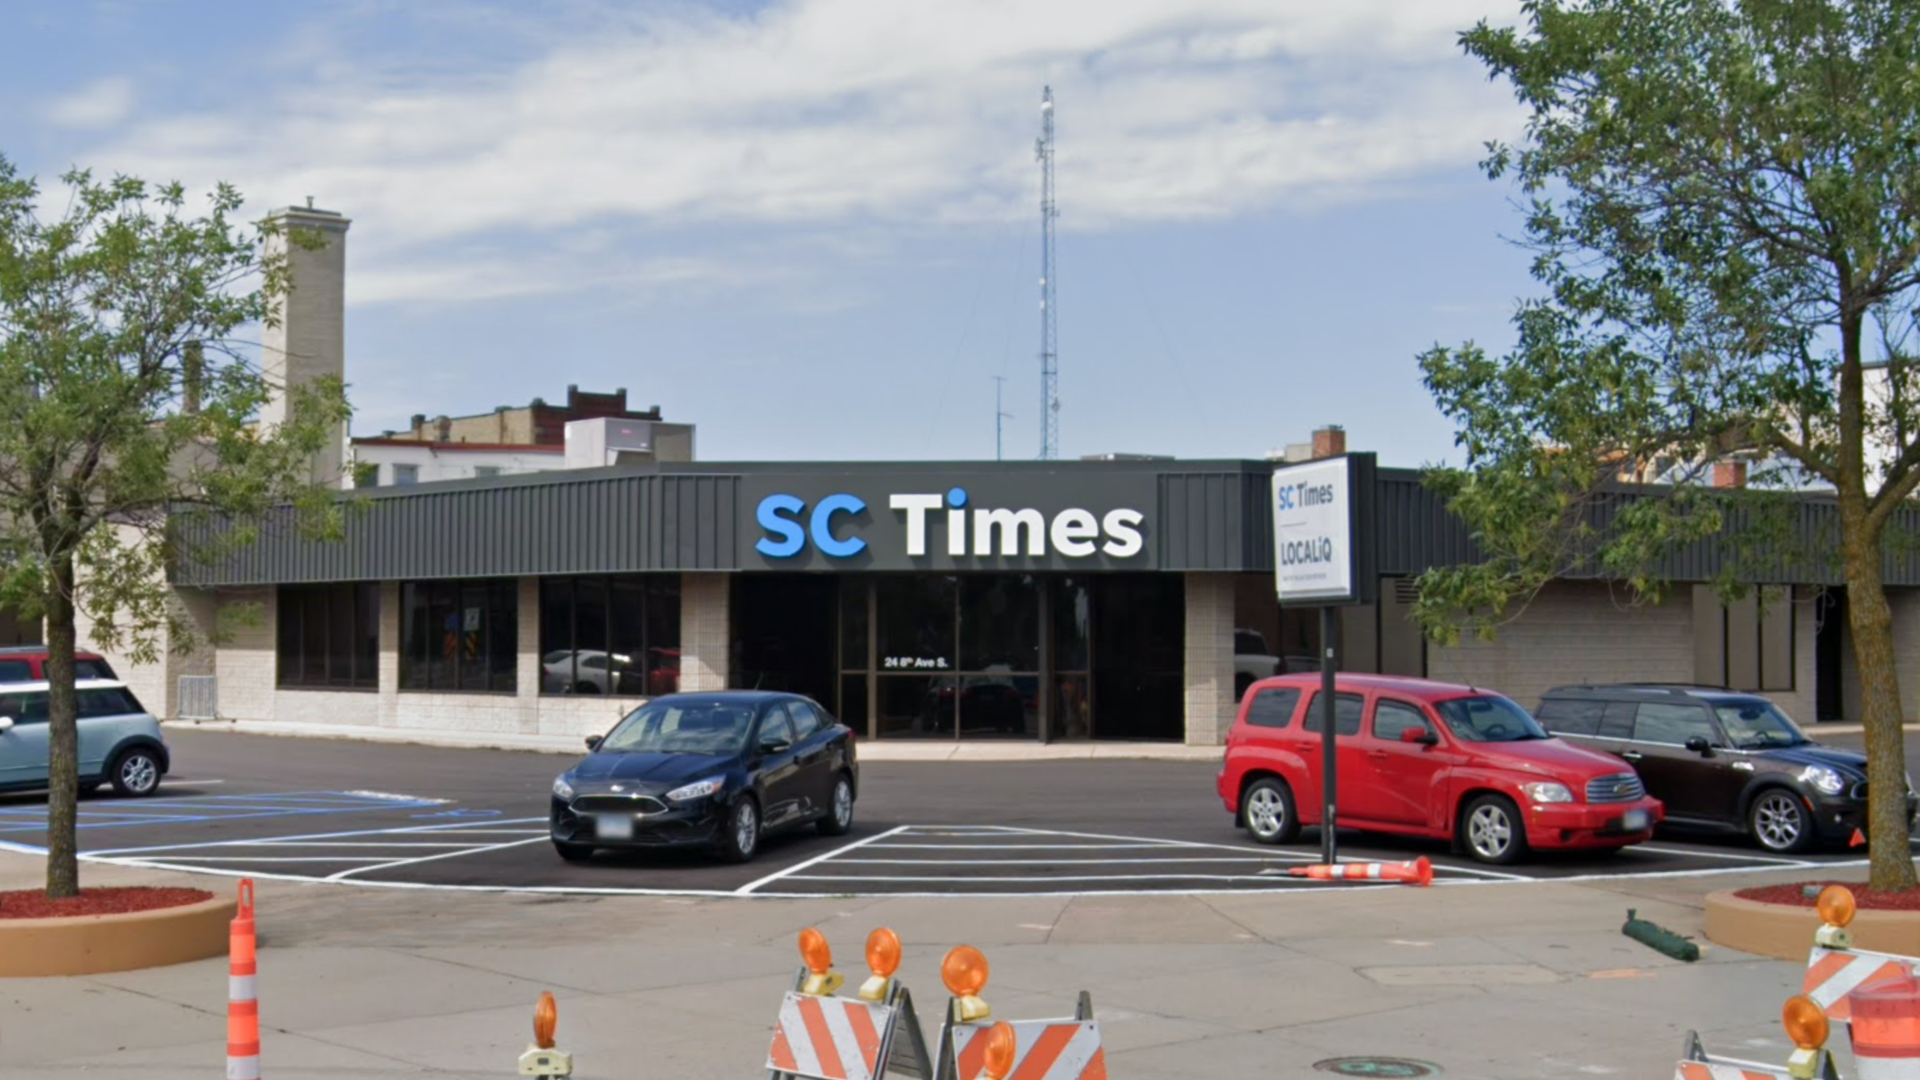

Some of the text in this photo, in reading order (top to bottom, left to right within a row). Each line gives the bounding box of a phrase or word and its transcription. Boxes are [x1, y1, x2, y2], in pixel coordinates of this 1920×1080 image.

[1279, 481, 1333, 510] SC Times
[755, 487, 1143, 557] SC Times
[884, 656, 898, 668] 24
[914, 656, 935, 668] Ave
